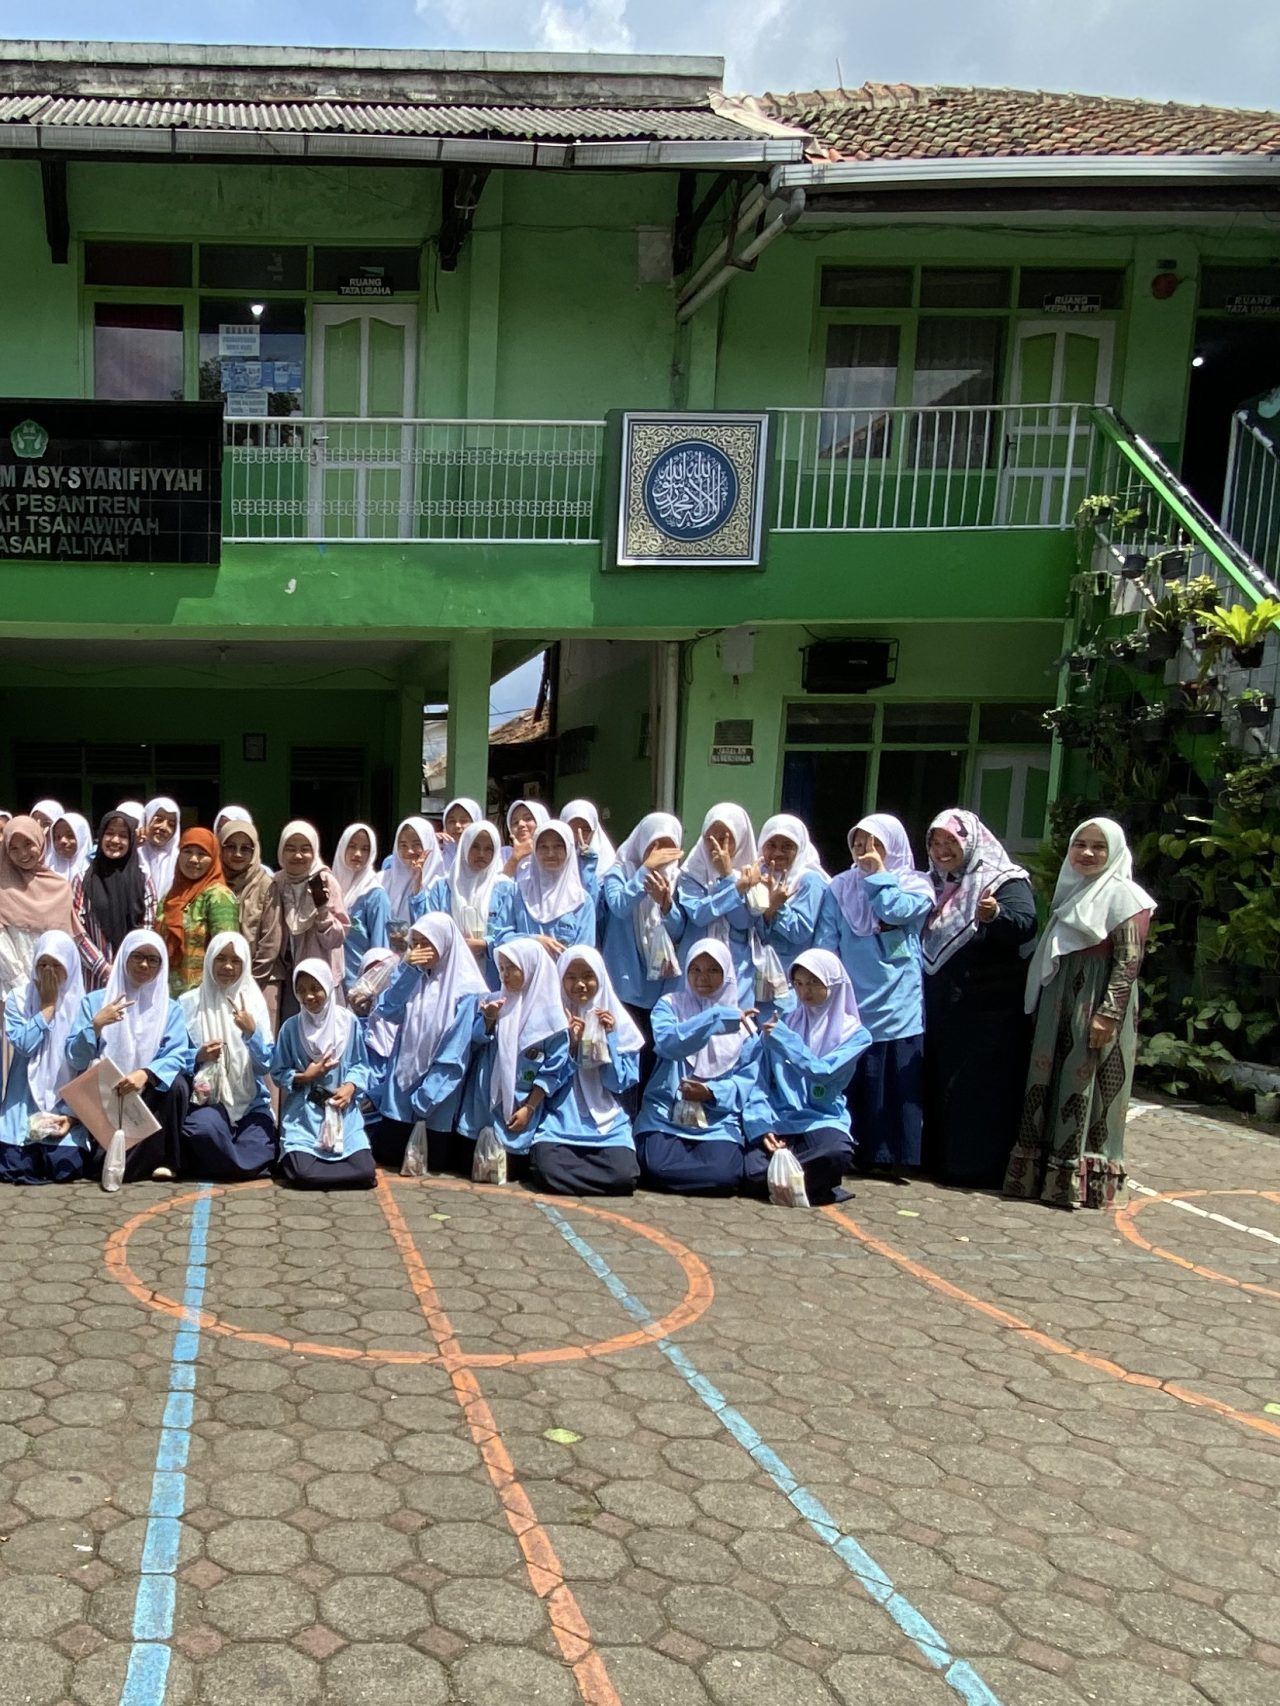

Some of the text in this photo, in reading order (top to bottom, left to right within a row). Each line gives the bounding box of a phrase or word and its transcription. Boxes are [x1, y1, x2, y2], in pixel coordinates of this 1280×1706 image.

[340, 286, 391, 295] TATA USAHA
[349, 278, 382, 287] RUANG
[1055, 296, 1088, 305] RUANG
[23, 465, 202, 491] ASY-SYARIFIYYAH
[16, 494, 140, 514] PESANTREN
[26, 515, 159, 535] TSANAWIYAH
[56, 536, 129, 555] ALIYAH
